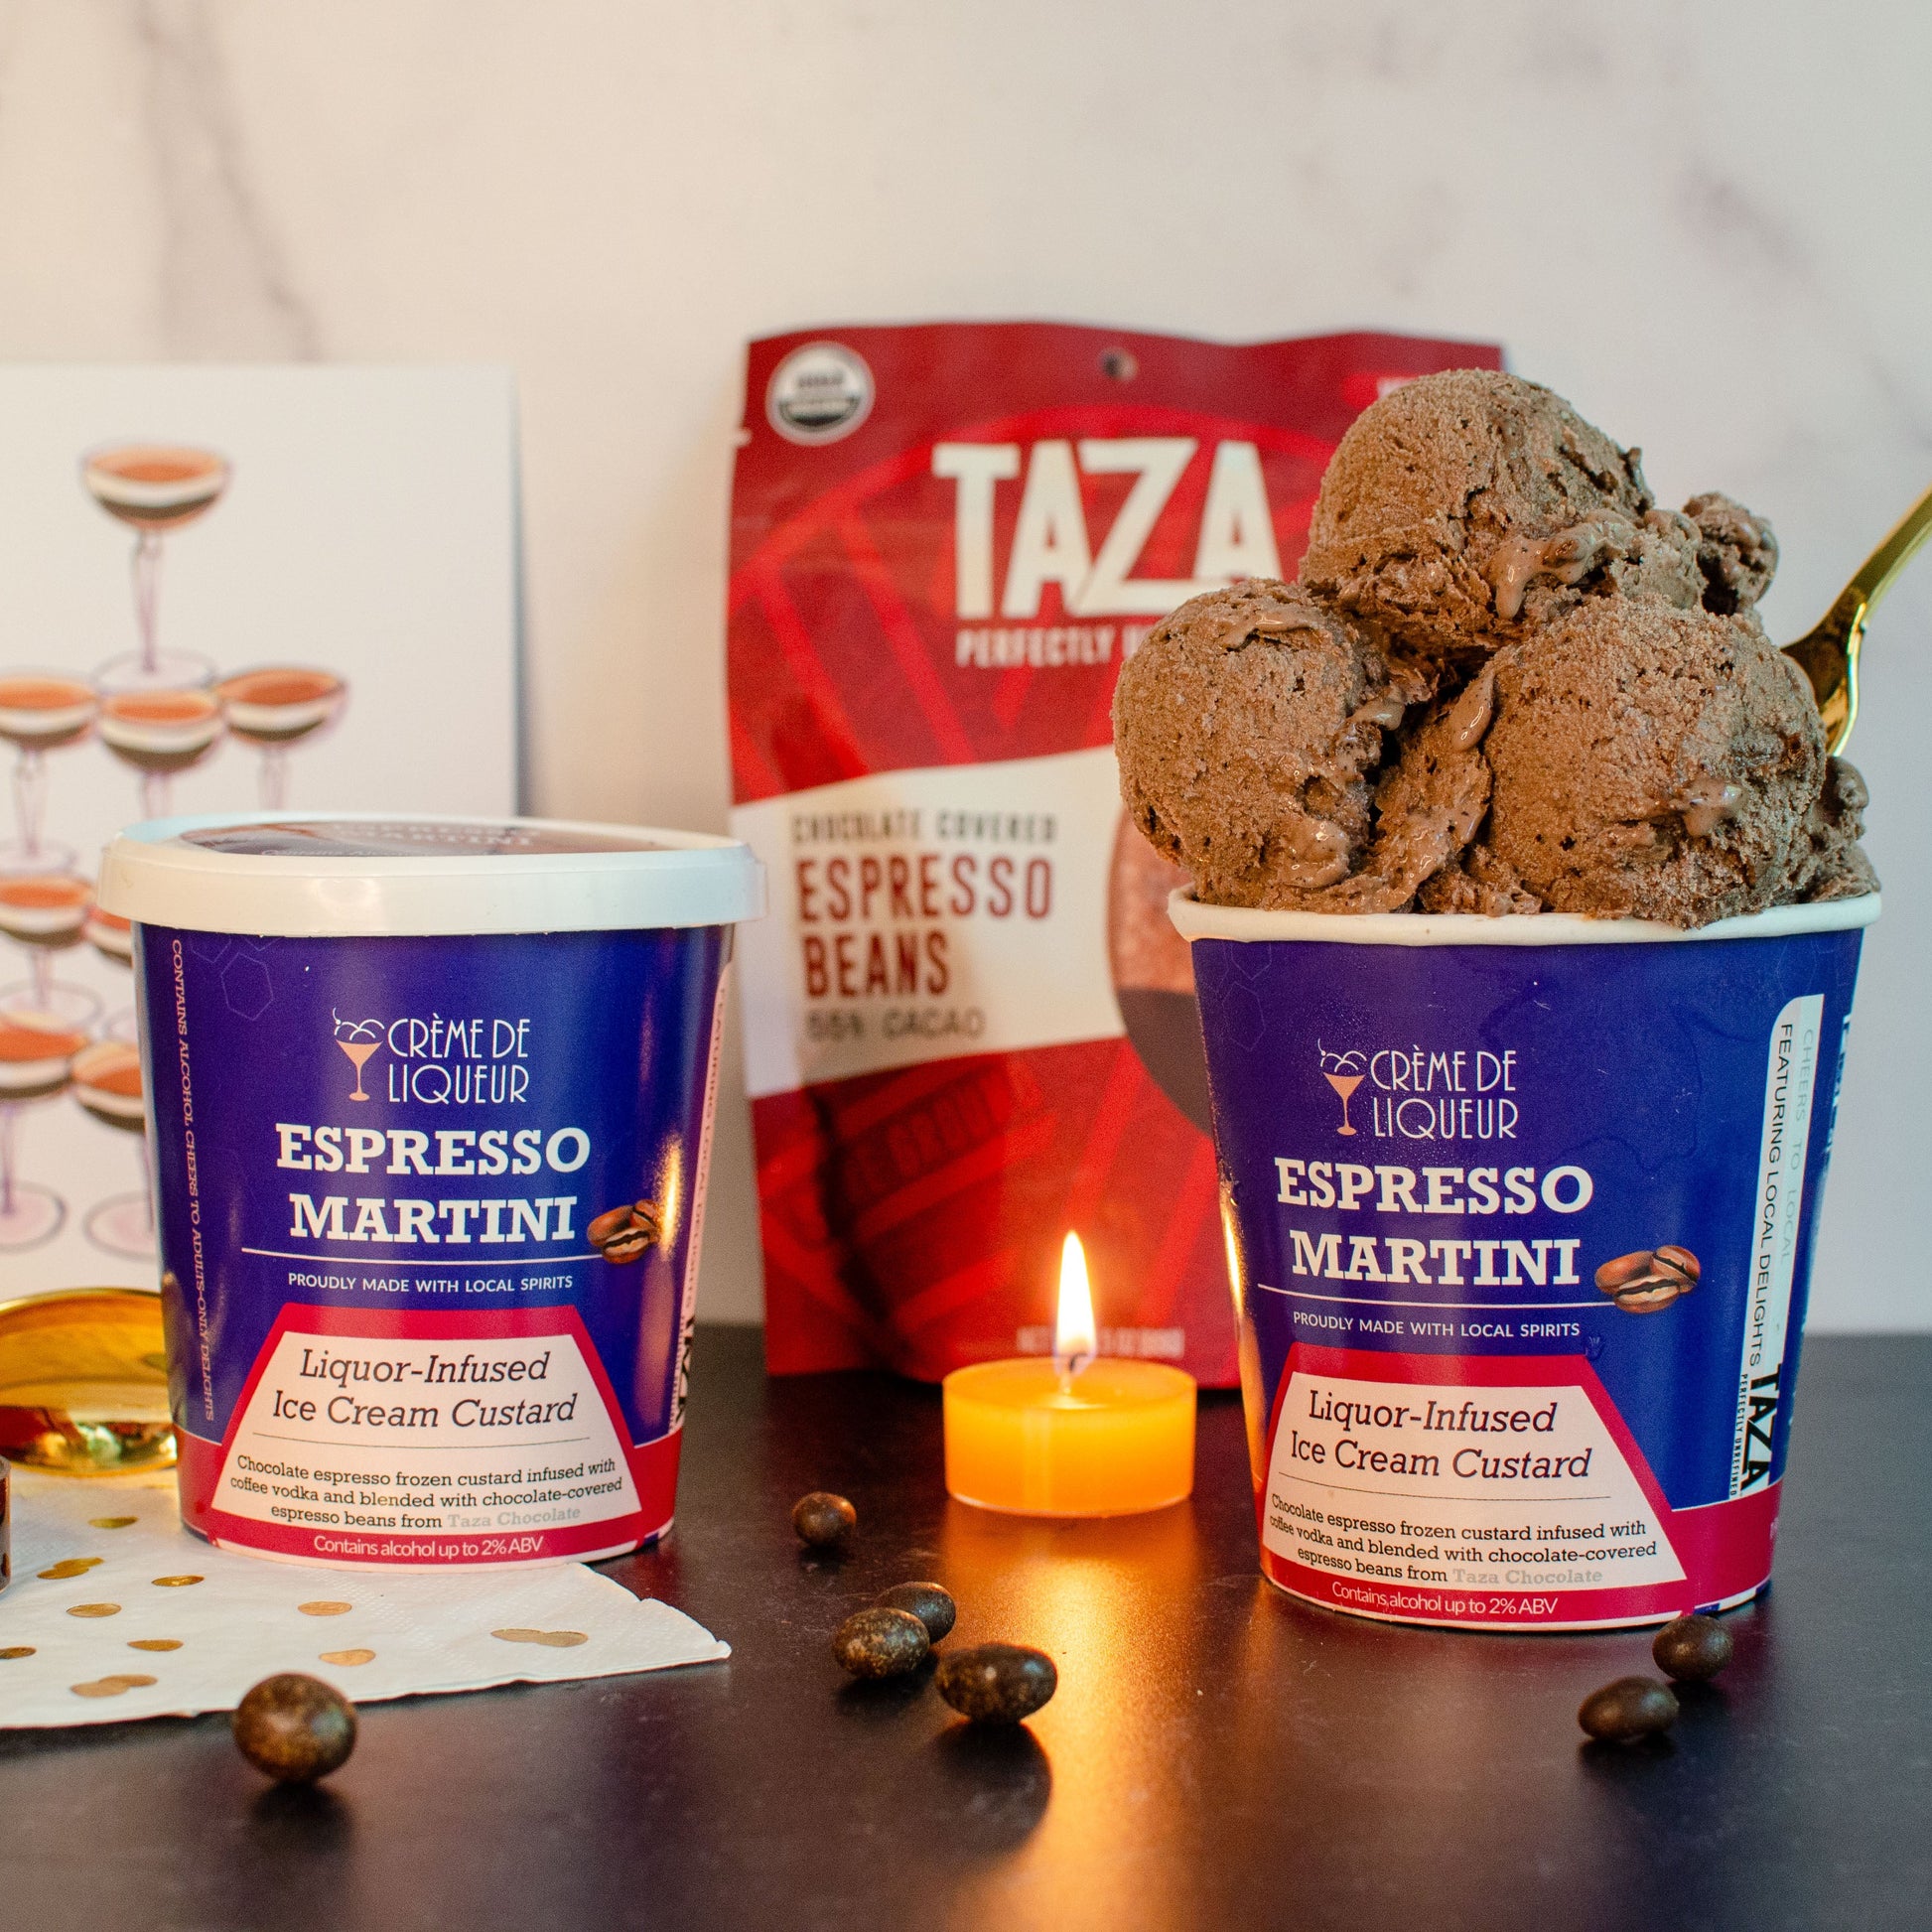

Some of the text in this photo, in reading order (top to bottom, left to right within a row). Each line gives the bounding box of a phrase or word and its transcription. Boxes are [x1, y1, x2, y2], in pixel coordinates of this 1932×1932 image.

[931, 436, 1285, 620] TAZA
[955, 625, 1115, 668] PERFECTLY
[793, 809, 1056, 842] CHOCOLATE COVERED
[796, 853, 1052, 922] ESPRESSO
[802, 929, 951, 999] BEANS
[388, 1013, 531, 1058] CRÈME DE
[882, 1007, 987, 1040] CACAO
[388, 1063, 529, 1104] LIQUEUR
[1370, 1044, 1517, 1092] CRÈME DE
[1795, 1029, 1814, 1122] CHEERS
[1373, 1097, 1519, 1140] LIQUEUR
[275, 1122, 591, 1175] ESPRESSO
[1790, 1139, 1803, 1171] TO
[172, 938, 214, 1422] CONTAINS ALCOHOL CHEERS TO ADULTS-ONLY DELIGHTS
[1274, 1157, 1593, 1215] ESPRESSO
[1749, 1023, 1793, 1367] FEATURING LOCAL DELIGHTS
[288, 1192, 578, 1244] MARTINI
[1289, 1229, 1582, 1286] MARTINI
[288, 1272, 573, 1294] PROUDLY MADE WITH LOCAL SPIRITS
[1293, 1311, 1581, 1338] PROUDLY MADE WITH LOCAL SPIRITS
[300, 1348, 551, 1390] Liquor-Infused
[273, 1390, 578, 1428] Ice Cream Custard
[1309, 1390, 1558, 1433] Liquor-Infused
[1740, 1364, 1782, 1491] TAZA
[236, 1454, 617, 1491] Chocolate espresso frozen custard infused with
[1292, 1431, 1592, 1479] Ice Cream Custard
[230, 1475, 623, 1508] coffee vodka and blended with chocolate-covered
[271, 1504, 581, 1529] espresso beans from Taza Chocolate
[1271, 1493, 1646, 1542] Chocolate espresso frozen custard infused with
[314, 1535, 544, 1560] Contains alcohol up to 2% ABV
[1270, 1513, 1658, 1564] coffee vodka and blended with chocolate-covered
[1298, 1546, 1603, 1585] espresso beans from Taza Chocolate
[1332, 1581, 1559, 1615] Contains alcohol up to 2% ABV
